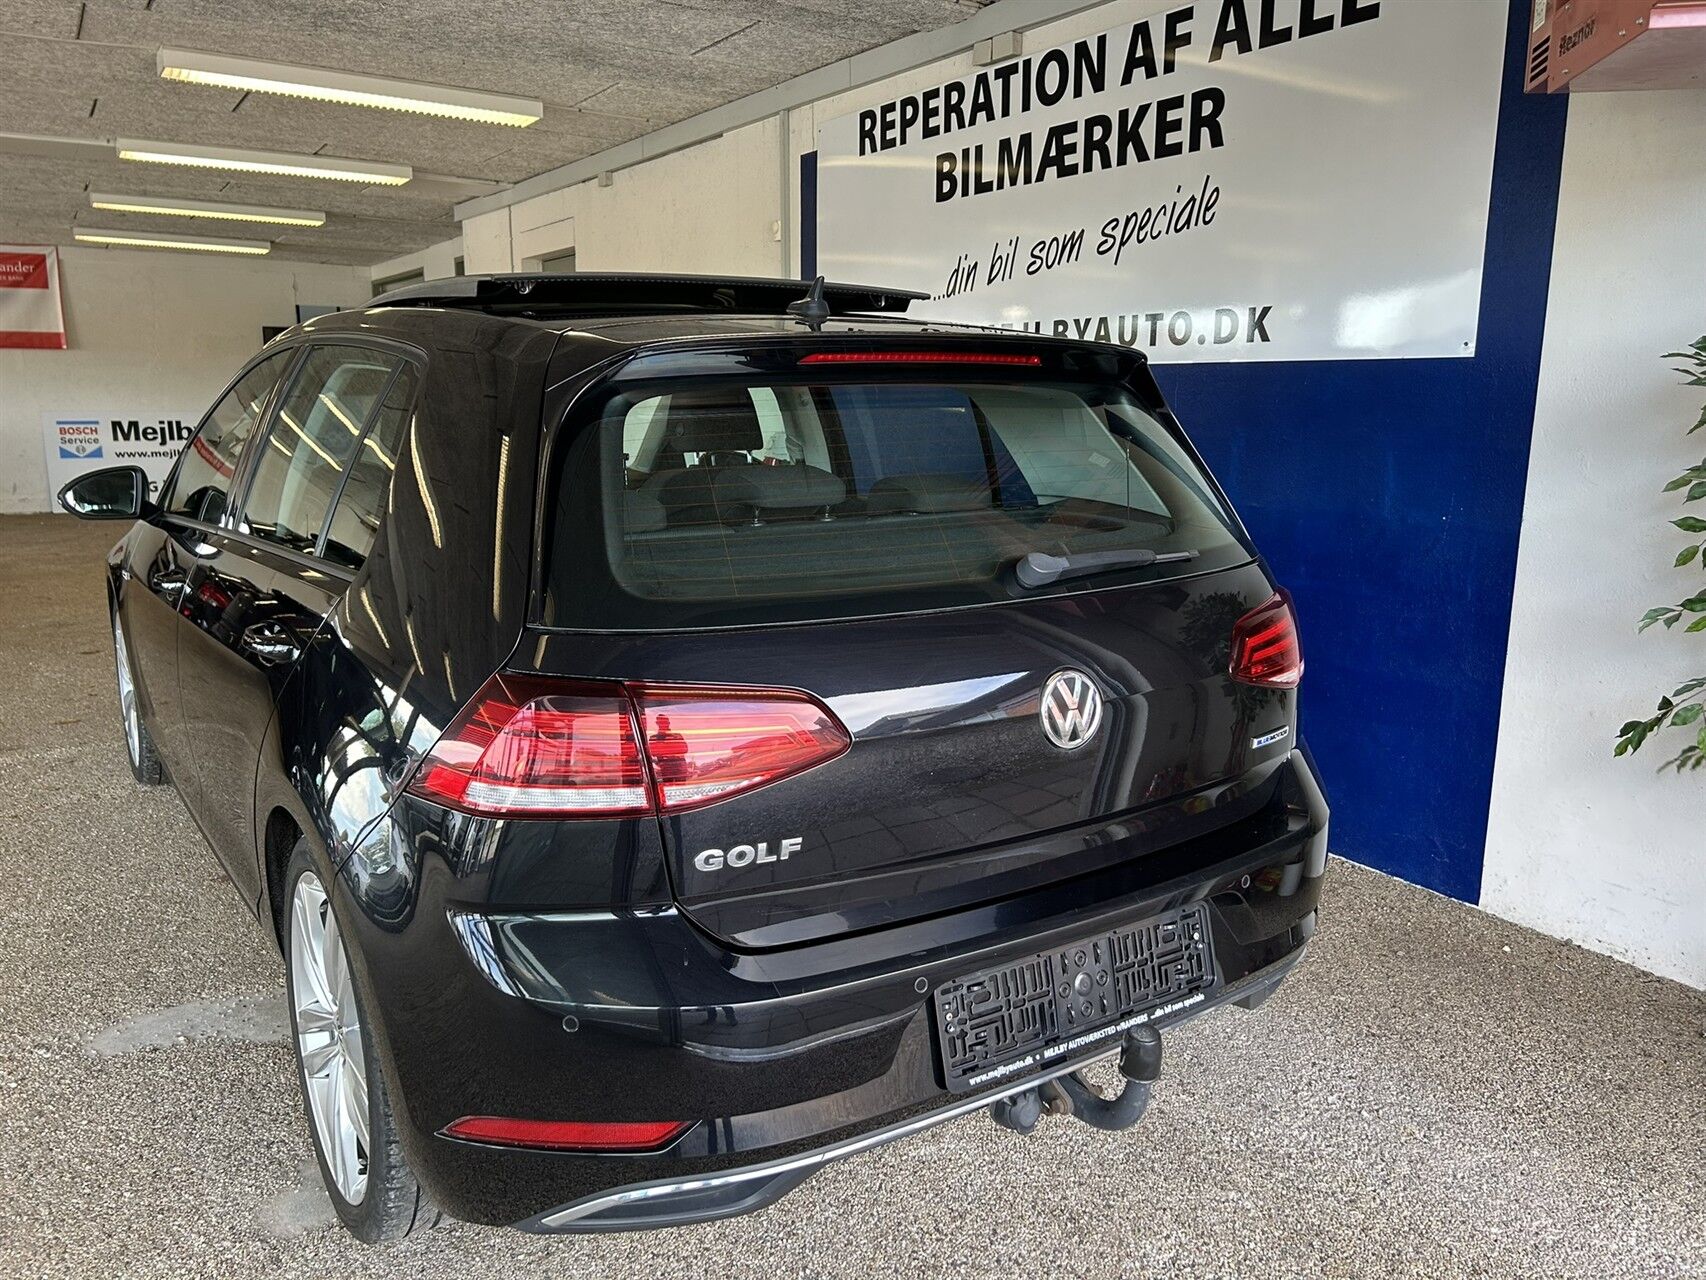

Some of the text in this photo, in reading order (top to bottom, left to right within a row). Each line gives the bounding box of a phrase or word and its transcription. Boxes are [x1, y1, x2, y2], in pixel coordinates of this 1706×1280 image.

[858, 33, 1108, 157] REPERATION
[1120, 5, 1195, 87] AF
[935, 86, 1226, 203] BILMÆRKER
[987, 235, 1020, 287] bil
[1026, 228, 1085, 276] som
[1096, 174, 1221, 266] speciale
[0, 260, 35, 273] ander
[58, 426, 99, 436] BOSCH
[60, 436, 100, 445] Service
[110, 420, 196, 446] Mejlb
[694, 836, 803, 872] GOLF
